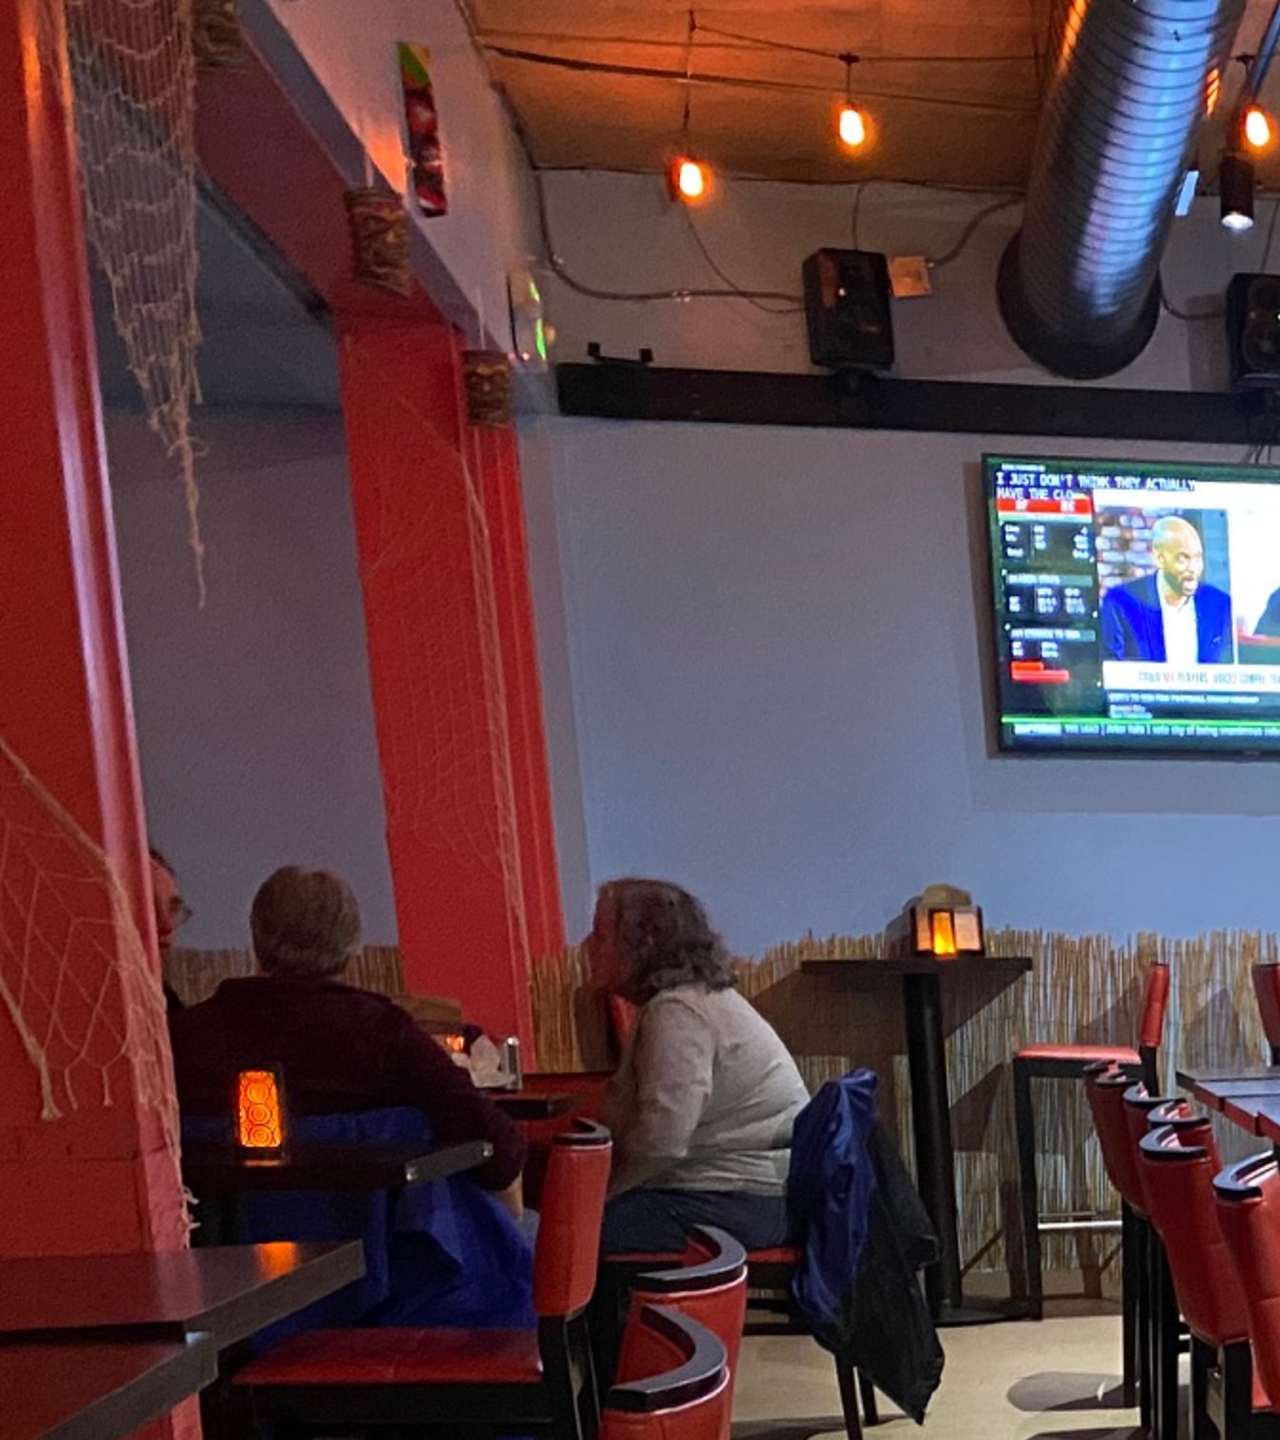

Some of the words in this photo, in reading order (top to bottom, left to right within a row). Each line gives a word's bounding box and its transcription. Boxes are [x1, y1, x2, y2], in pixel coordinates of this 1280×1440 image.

[1009, 472, 1035, 486] JUST
[1039, 474, 1073, 487] DON'T
[1146, 478, 1196, 491] ACTUALLY
[996, 487, 1024, 499] HAVE
